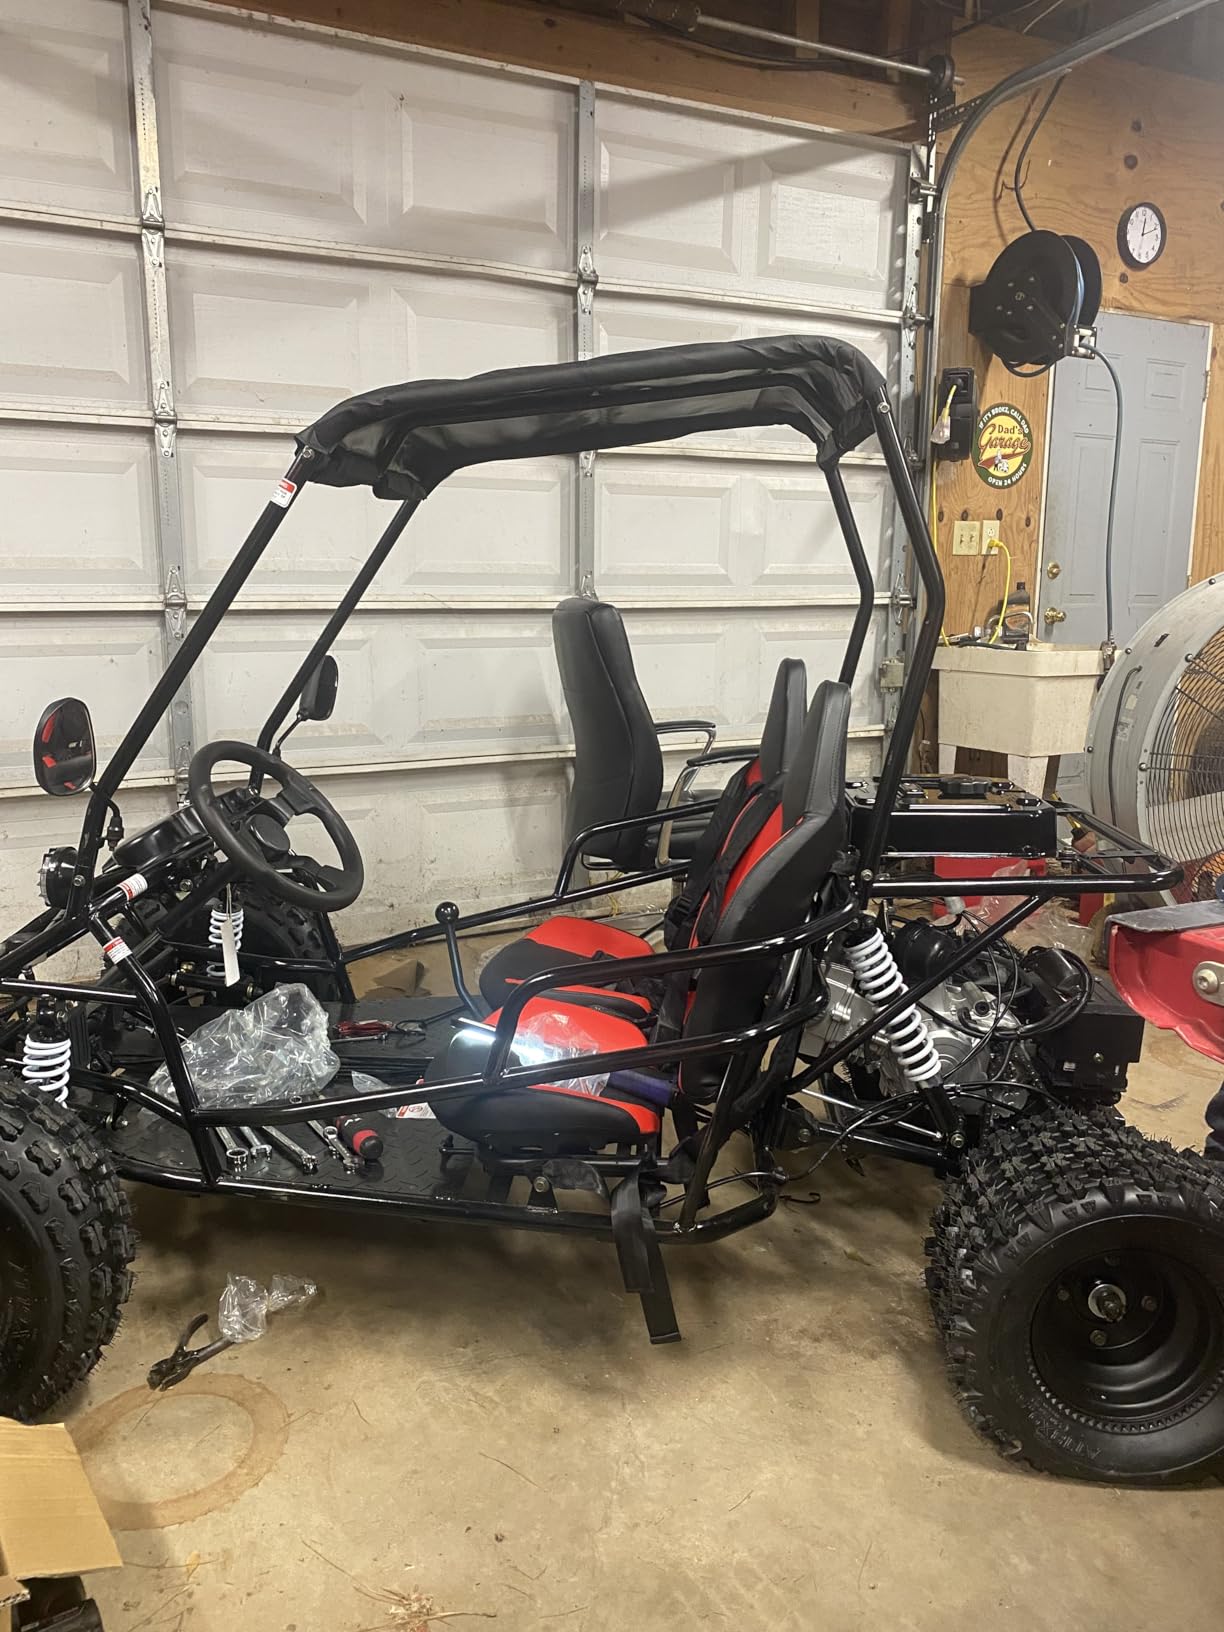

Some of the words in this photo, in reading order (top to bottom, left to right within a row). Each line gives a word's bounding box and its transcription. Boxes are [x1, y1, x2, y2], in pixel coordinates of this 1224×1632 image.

[997, 424, 1023, 435] Dad's
[1010, 409, 1022, 422] CALL
[1020, 420, 1030, 434] DAD
[978, 423, 1031, 458] Garage
[987, 476, 1003, 487] OPEN
[1003, 478, 1011, 486] 24
[1011, 463, 1028, 483] HOURS
